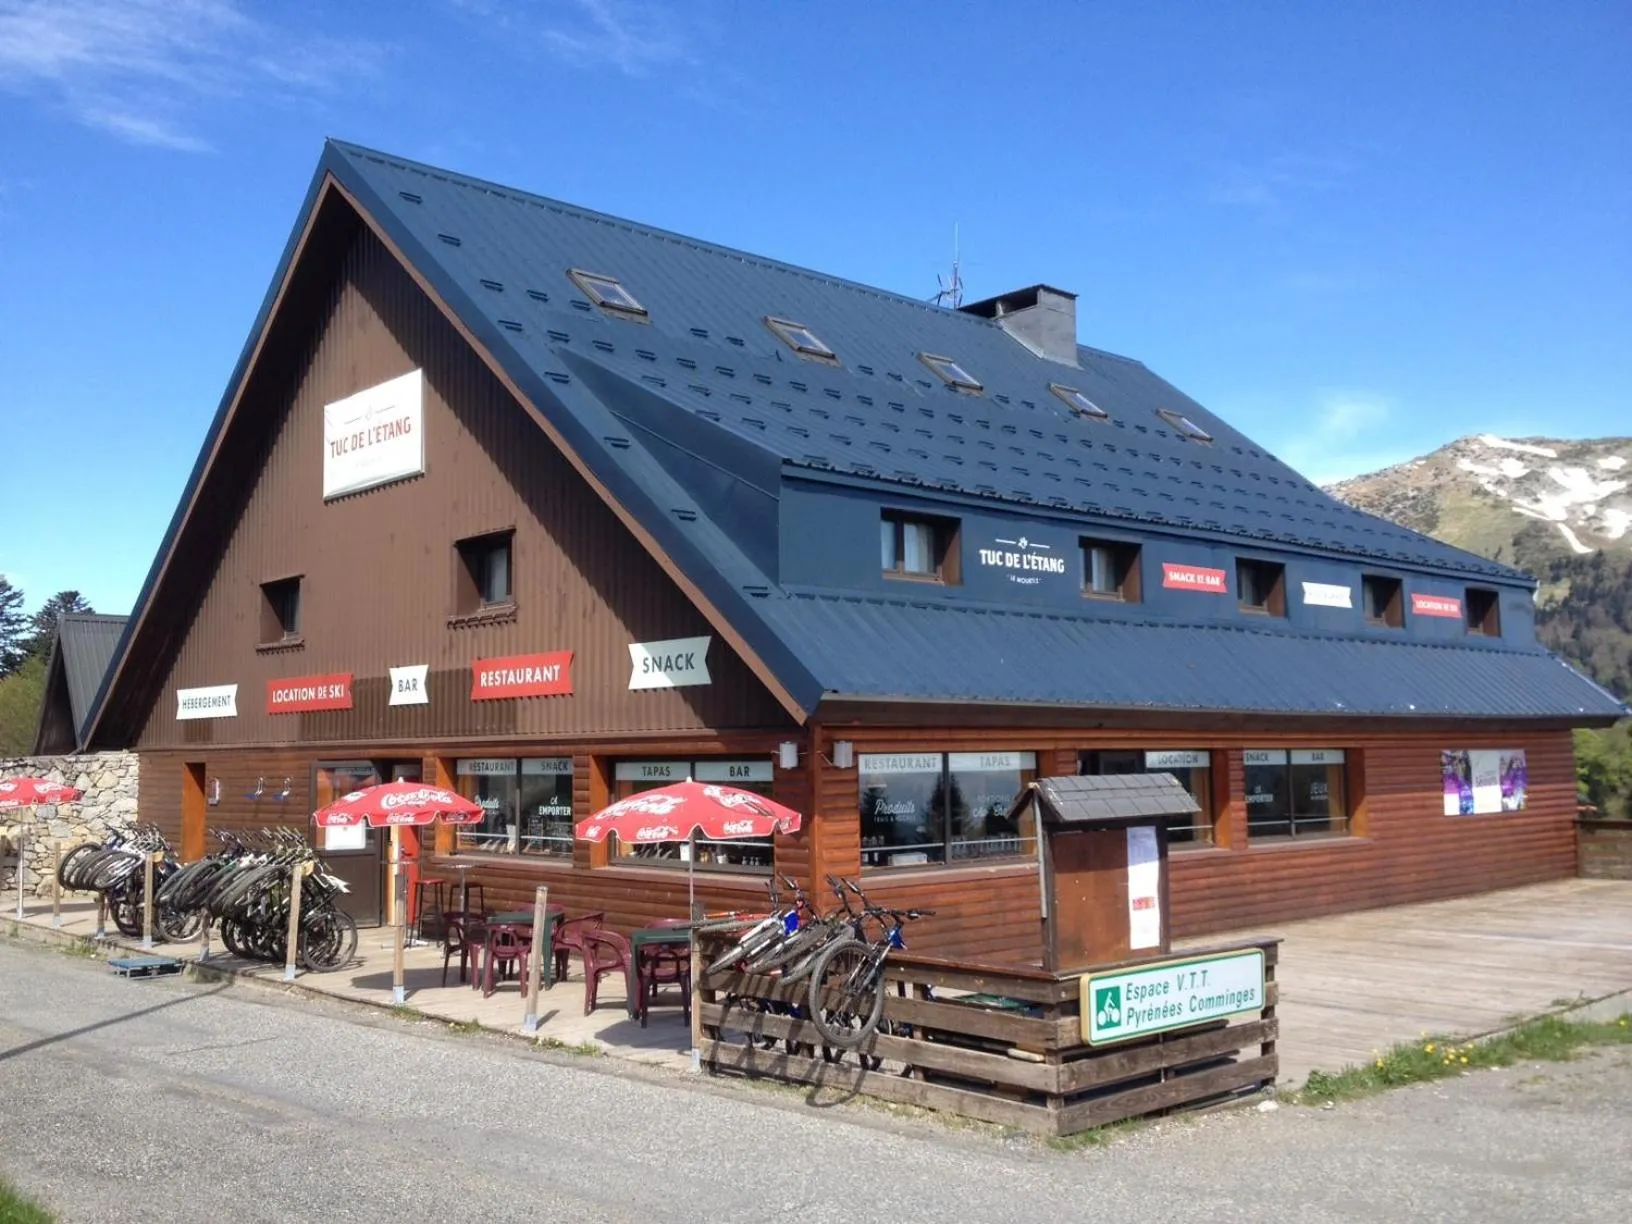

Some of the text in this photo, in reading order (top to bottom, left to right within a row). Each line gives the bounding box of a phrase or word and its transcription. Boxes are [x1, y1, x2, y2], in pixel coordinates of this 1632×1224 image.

[330, 437, 348, 458] TUC
[351, 431, 364, 451] DE
[979, 549, 1065, 574] TUC DE L'ÉTANG
[1169, 571, 1195, 584] SNACK
[1206, 576, 1220, 586] BAR
[642, 653, 695, 674] SNACK
[480, 664, 560, 688] RESTAURANT
[397, 678, 418, 692] BAR
[272, 684, 344, 703] LOCATION DE SKI
[468, 761, 515, 773] RESTAURANT
[541, 761, 568, 773] SNACK
[864, 757, 937, 770] RESTAURANT
[979, 756, 1011, 769] TAPAS
[1158, 755, 1198, 765] LOCATION
[642, 766, 671, 777] TAPAS
[729, 766, 750, 777] BAR
[538, 806, 571, 816] EMPORTER
[874, 799, 915, 815] Produits
[1126, 970, 1210, 1004] Espace V.T.T.
[1127, 987, 1255, 1028] Pyrénées Comminges
